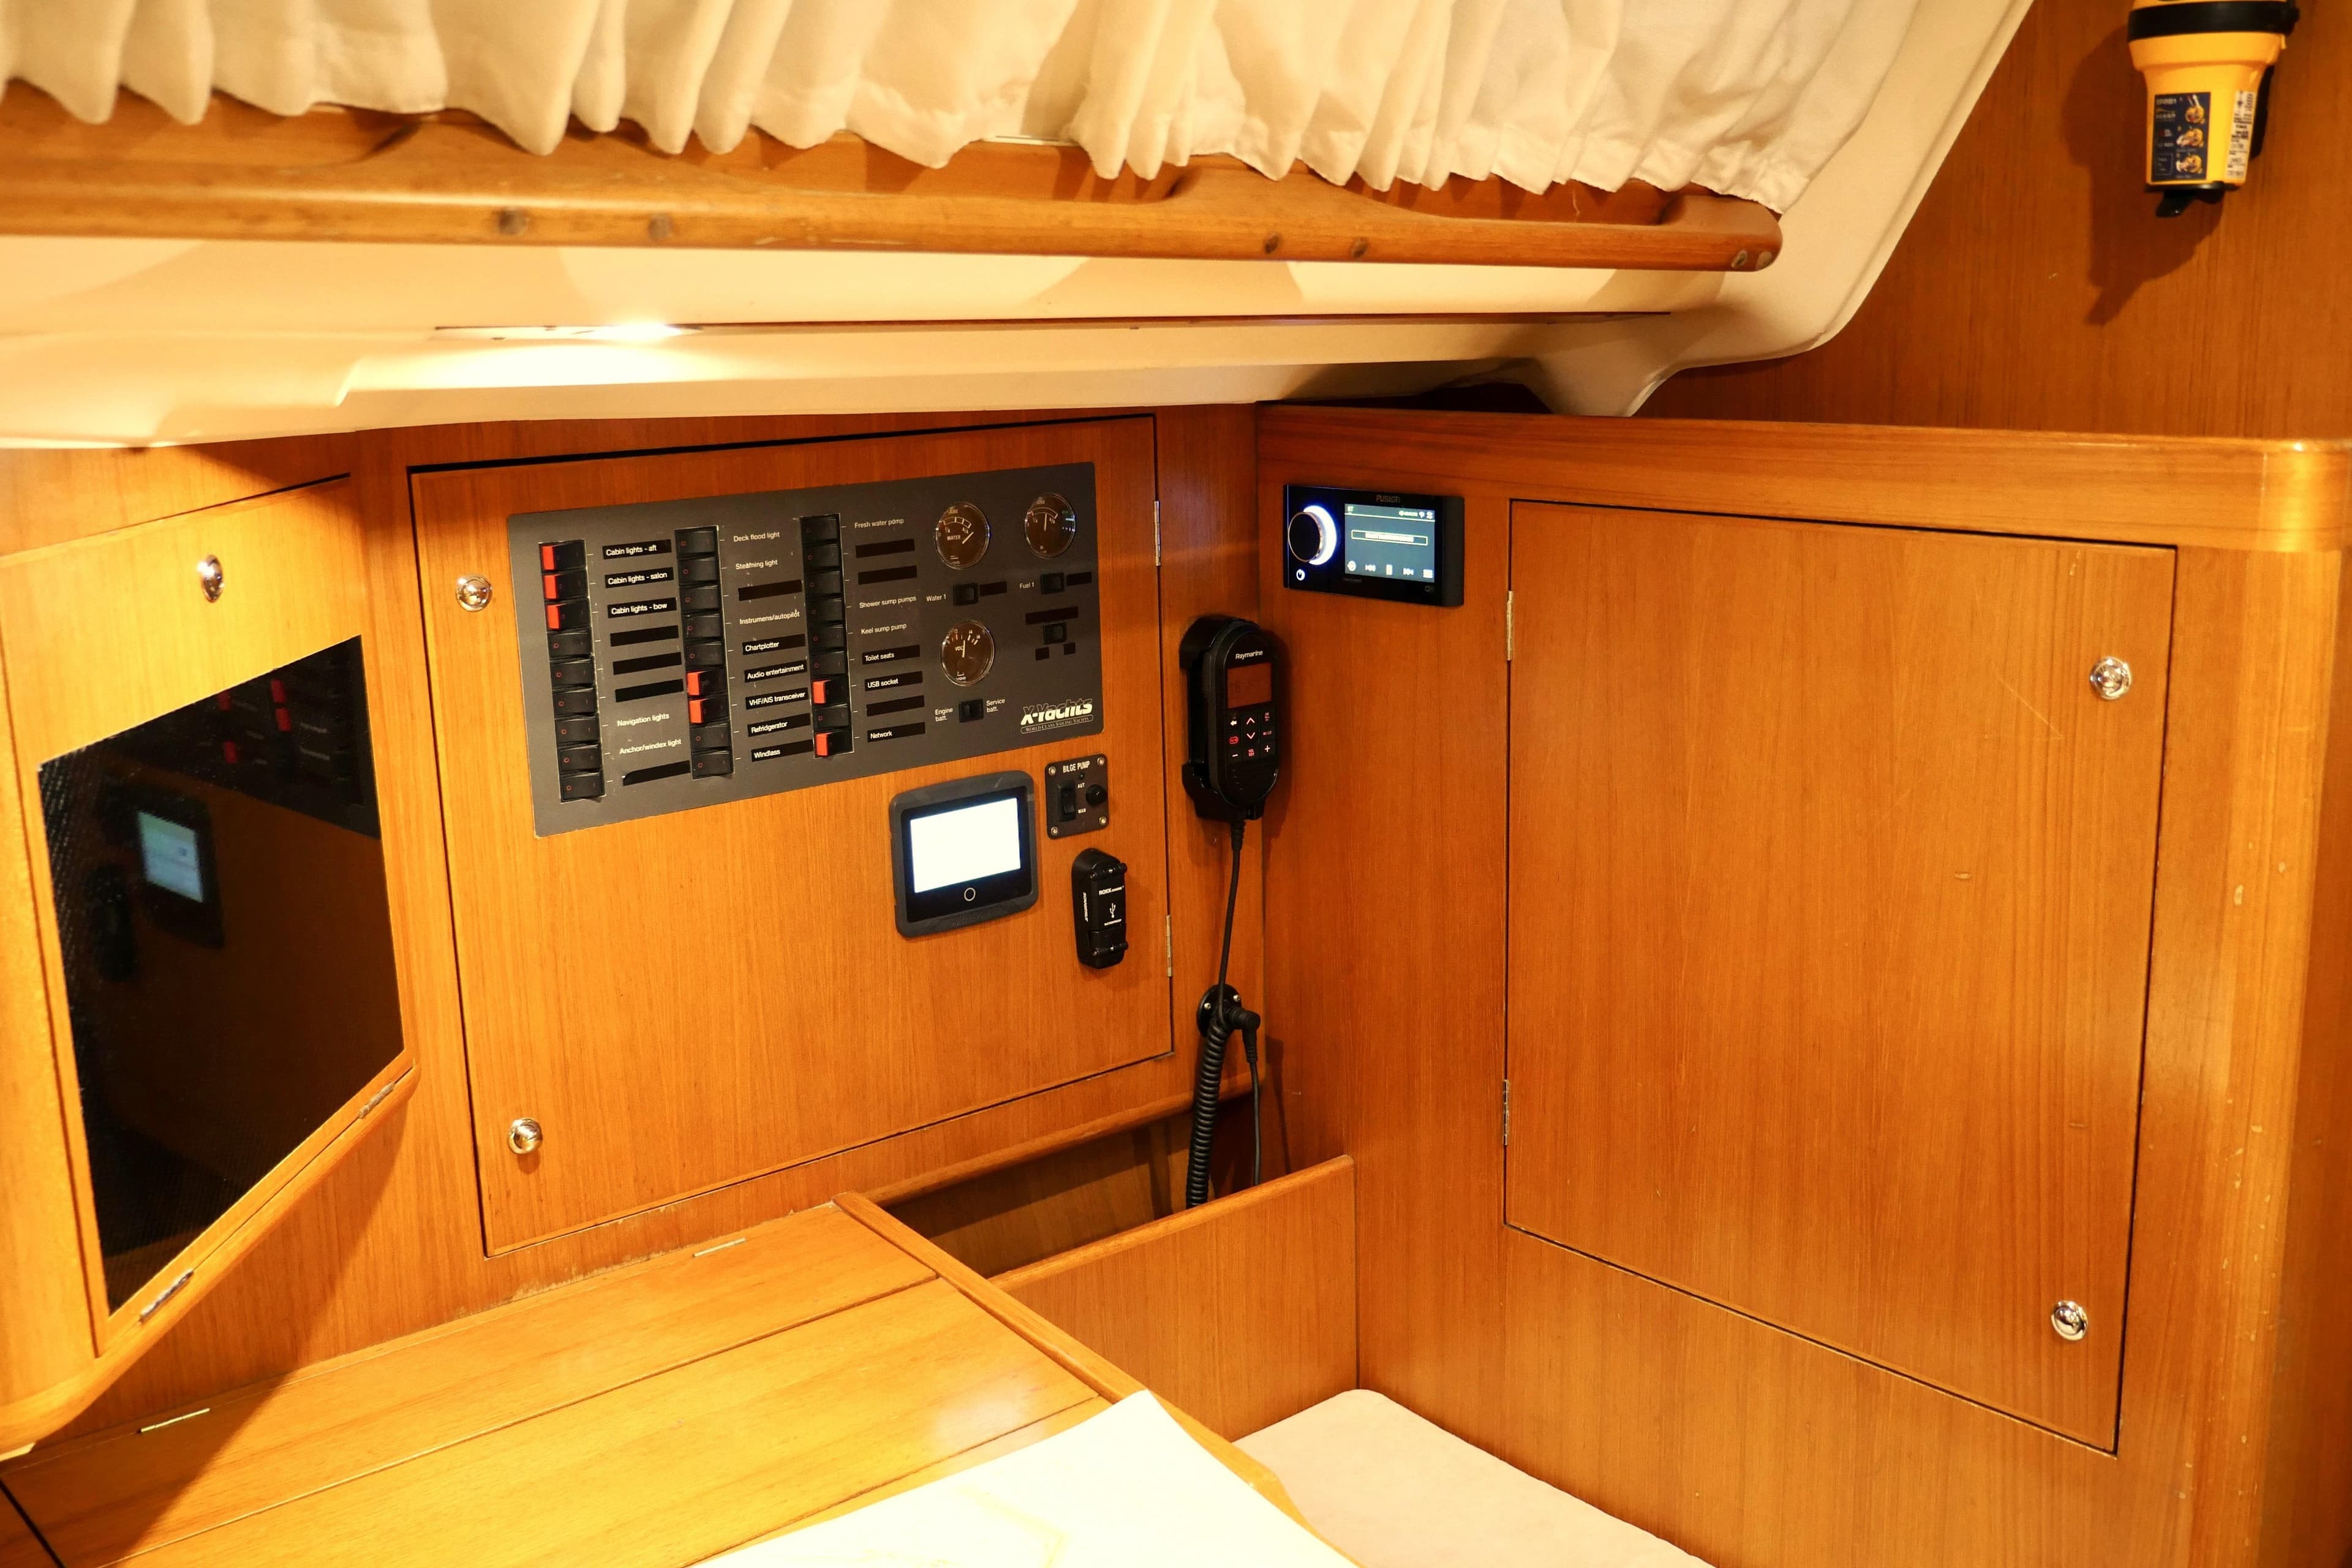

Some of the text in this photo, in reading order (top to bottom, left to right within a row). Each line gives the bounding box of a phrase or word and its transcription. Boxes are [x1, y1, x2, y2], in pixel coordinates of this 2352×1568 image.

[606, 548, 625, 556] Cabin
[626, 546, 643, 555] lights
[608, 576, 627, 585] Cabin
[611, 606, 630, 614] Cabin
[630, 605, 647, 613] lights
[740, 611, 800, 624] Instrumens/autopilot
[745, 642, 779, 652] Chartplotter
[1235, 650, 1263, 660] Raymarine
[747, 664, 804, 679] Audio entertainment
[748, 692, 805, 706] VHF/AIS transceiver
[1020, 698, 1093, 725] X-Yachts
[617, 713, 669, 726] Navigation lights
[751, 722, 788, 733] Refridgerator
[870, 730, 892, 739] Network
[619, 739, 681, 755] Anchor/windex light
[754, 749, 780, 759] Windlass
[1063, 761, 1090, 773] BILGE PUMP
